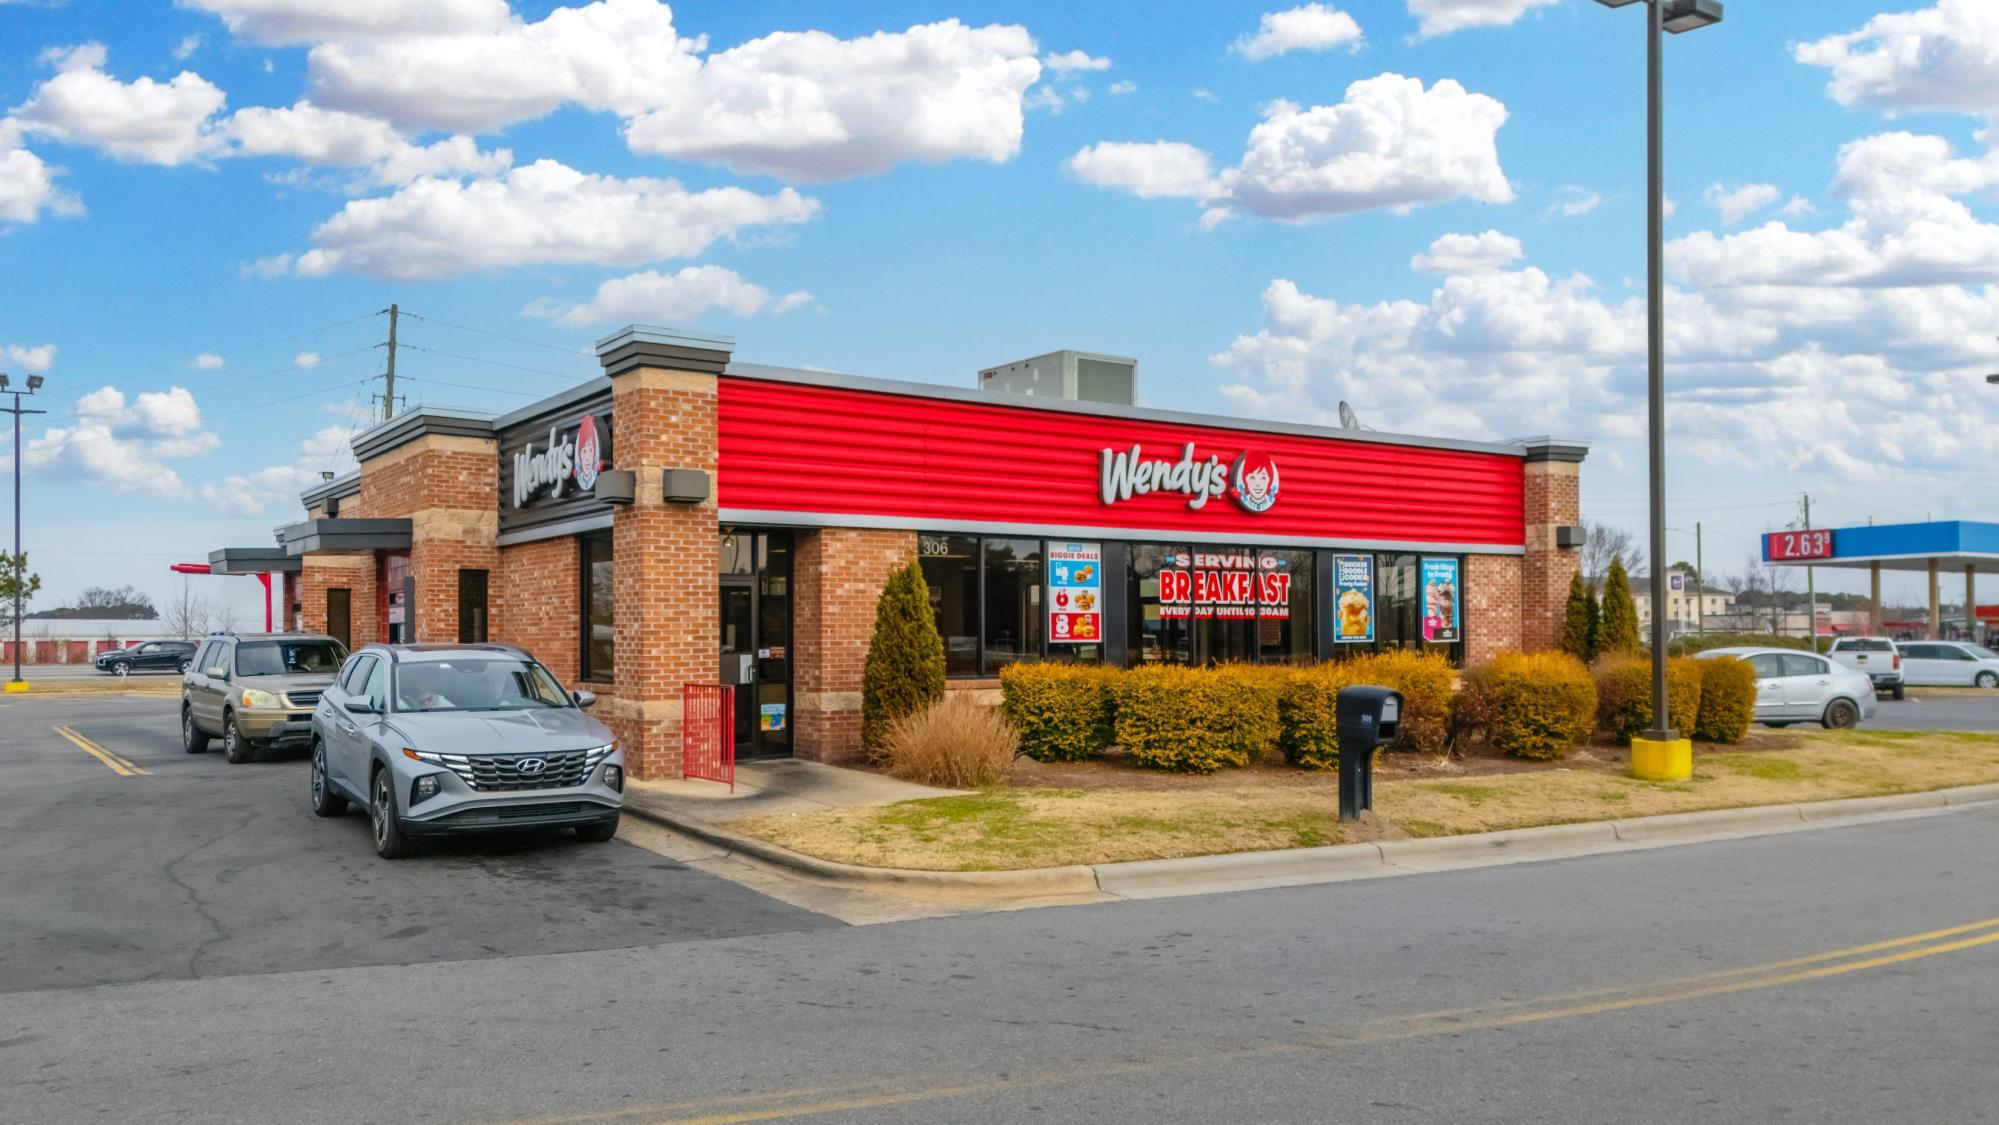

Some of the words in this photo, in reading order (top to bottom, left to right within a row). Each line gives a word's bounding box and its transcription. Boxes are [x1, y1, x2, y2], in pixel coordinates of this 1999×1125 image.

[513, 427, 573, 508] Wendy's
[1102, 442, 1227, 509] Wendy's
[923, 542, 949, 555] 306
[1050, 551, 1075, 559] BIGGIE
[1160, 570, 1290, 605] BREAKFAST
[1160, 606, 1191, 616] EVERY
[1217, 607, 1244, 616] UNTIL
